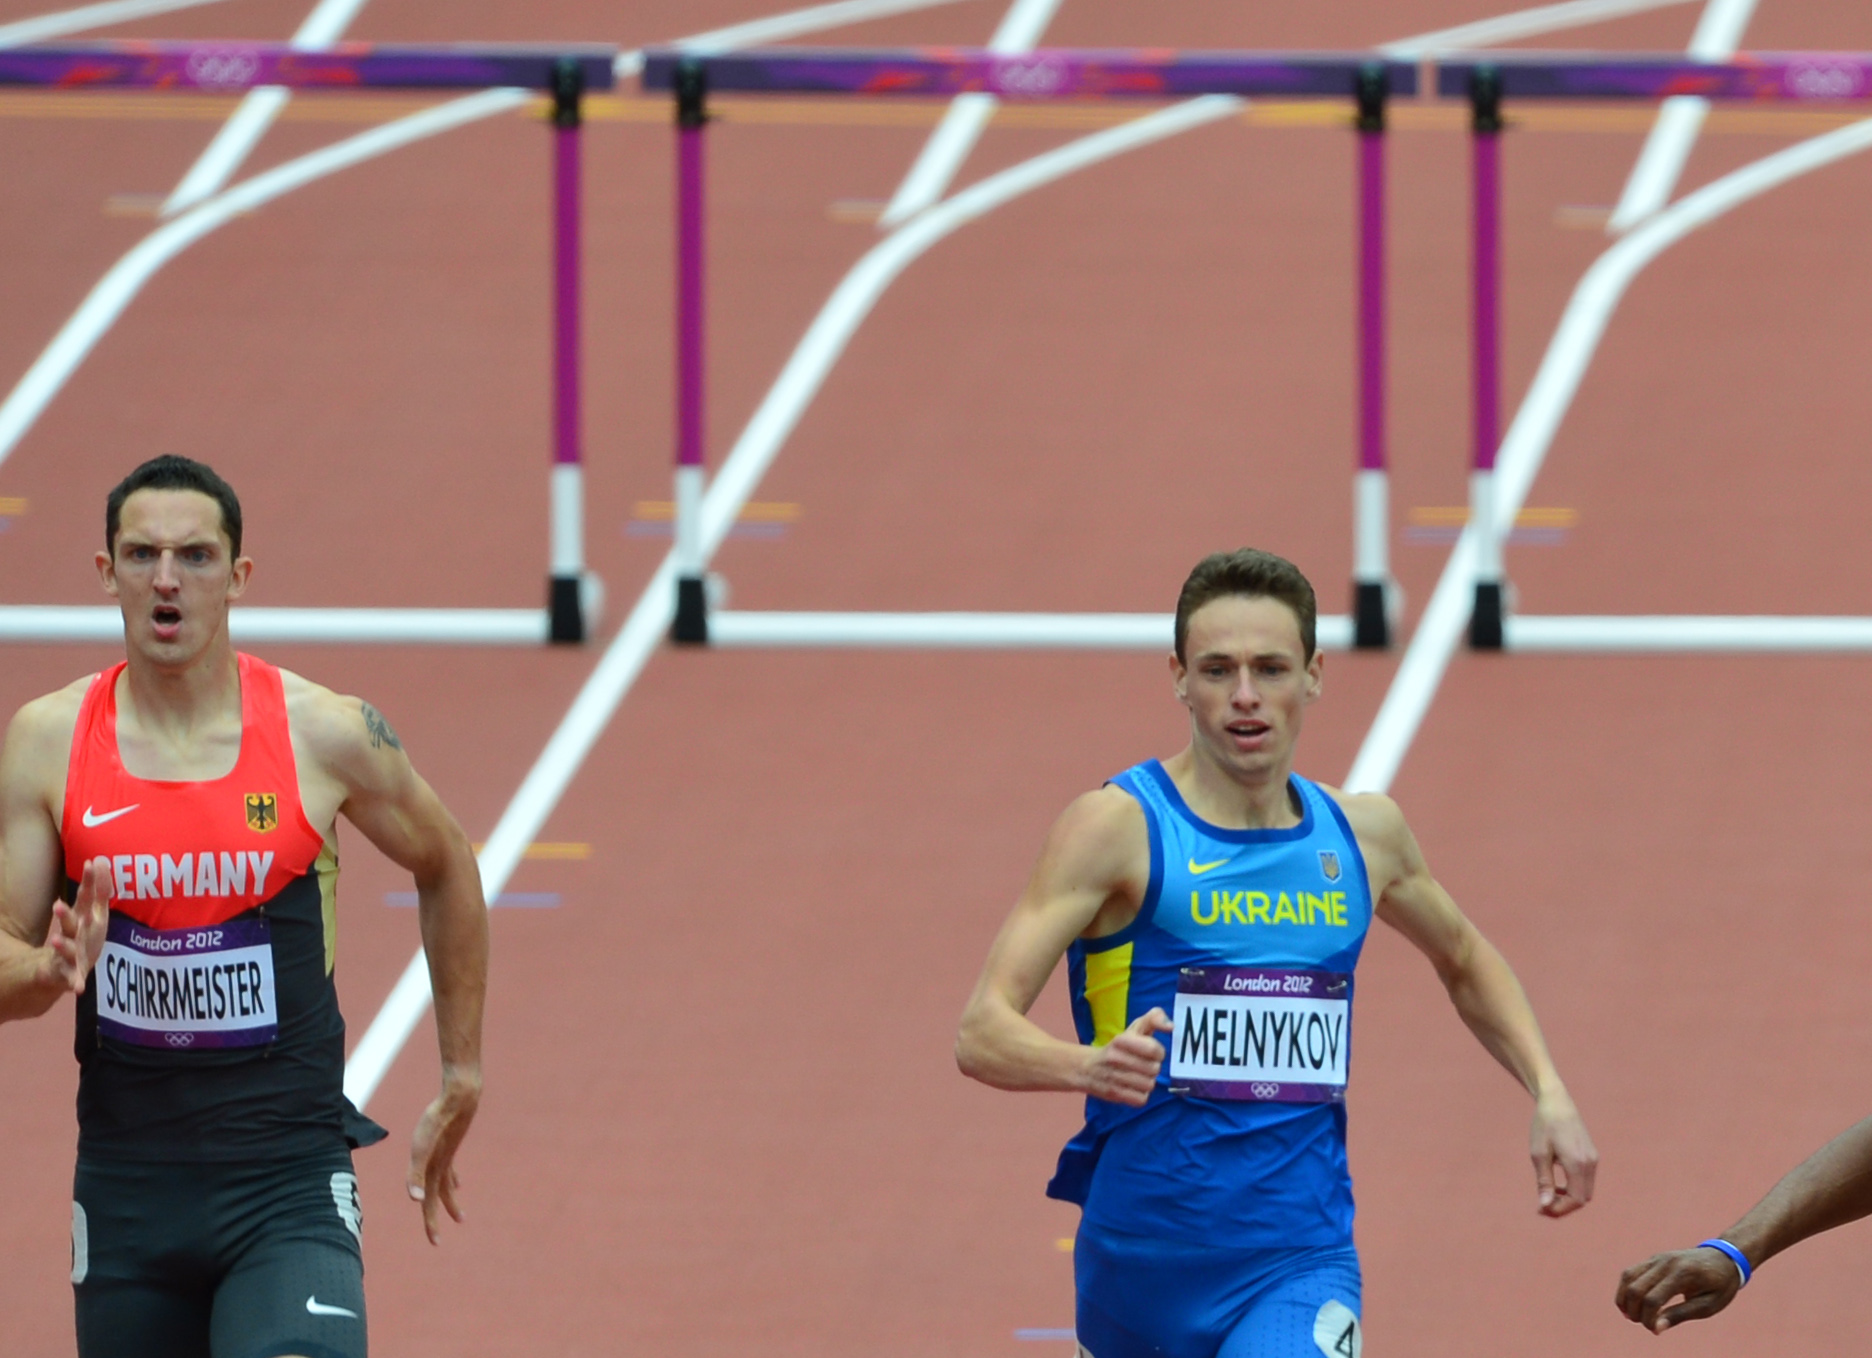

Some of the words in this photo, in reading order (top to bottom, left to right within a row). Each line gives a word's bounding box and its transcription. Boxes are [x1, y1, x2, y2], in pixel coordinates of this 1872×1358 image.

[1190, 890, 1348, 926] UKRAINE
[130, 928, 182, 951] London
[185, 929, 224, 948] 2012
[106, 952, 265, 1021] SCHIRRMEISTER
[1224, 973, 1281, 993] London
[1282, 974, 1314, 993] 2012
[1179, 1005, 1342, 1071] MELNYKOV
